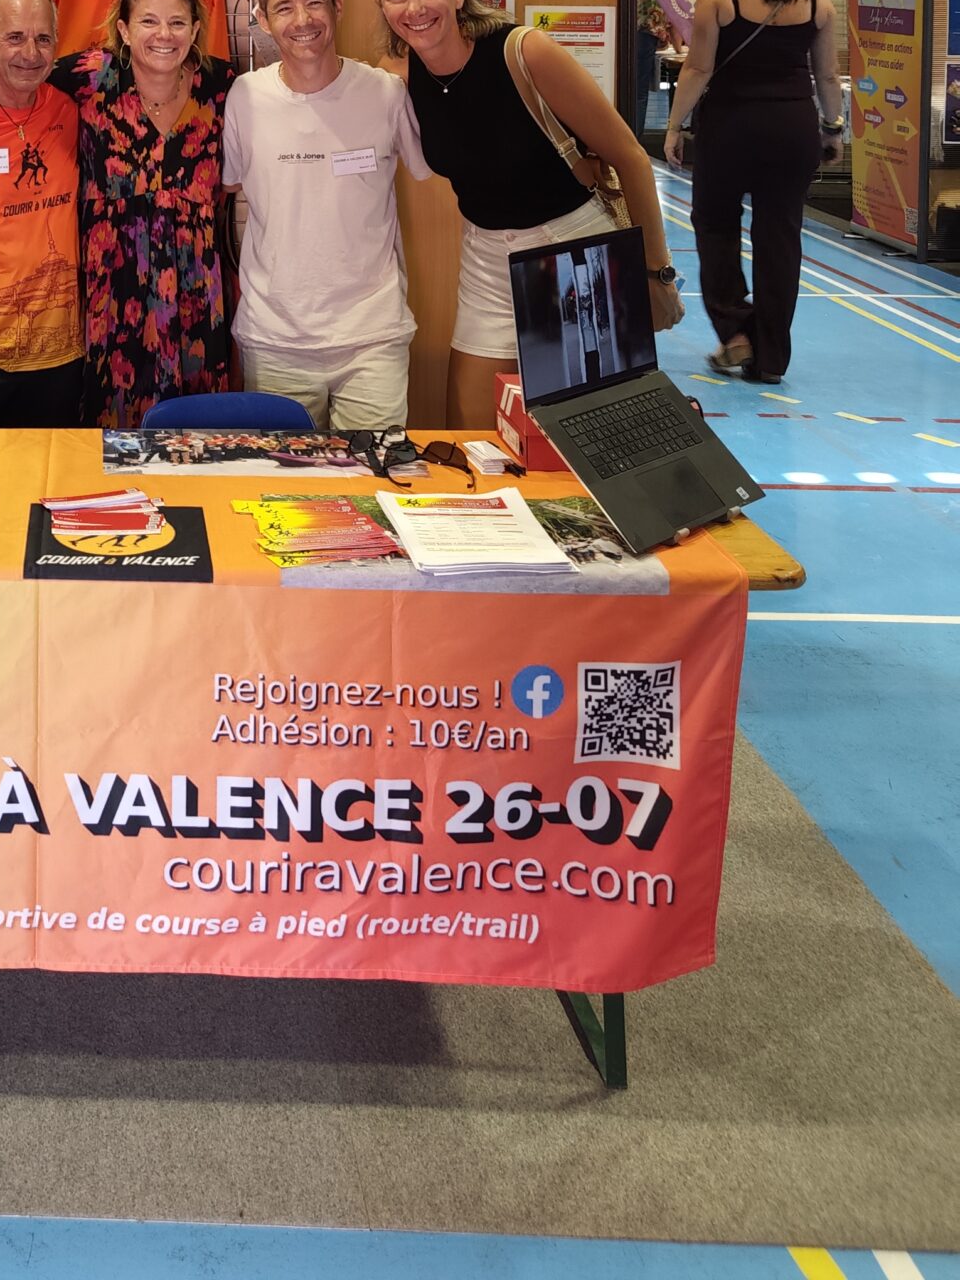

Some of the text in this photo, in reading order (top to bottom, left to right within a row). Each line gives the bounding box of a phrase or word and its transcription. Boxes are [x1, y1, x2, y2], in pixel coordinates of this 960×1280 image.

[302, 152, 325, 160] Jones
[2, 201, 33, 217] COURIR
[42, 192, 72, 209] VALENCE
[35, 554, 107, 566] COURIR
[121, 554, 201, 567] VALENCE
[213, 673, 503, 711] Rejoignez-nous !
[211, 714, 530, 752] Adhésion : 10€/an
[63, 773, 424, 843] VALENCE
[444, 776, 674, 851] 26-07
[163, 852, 676, 906] couriravalence.com
[87, 906, 126, 932] de
[135, 913, 239, 937] course
[248, 911, 266, 934] à
[276, 910, 348, 940] pied
[356, 913, 541, 944] (route/trail)
